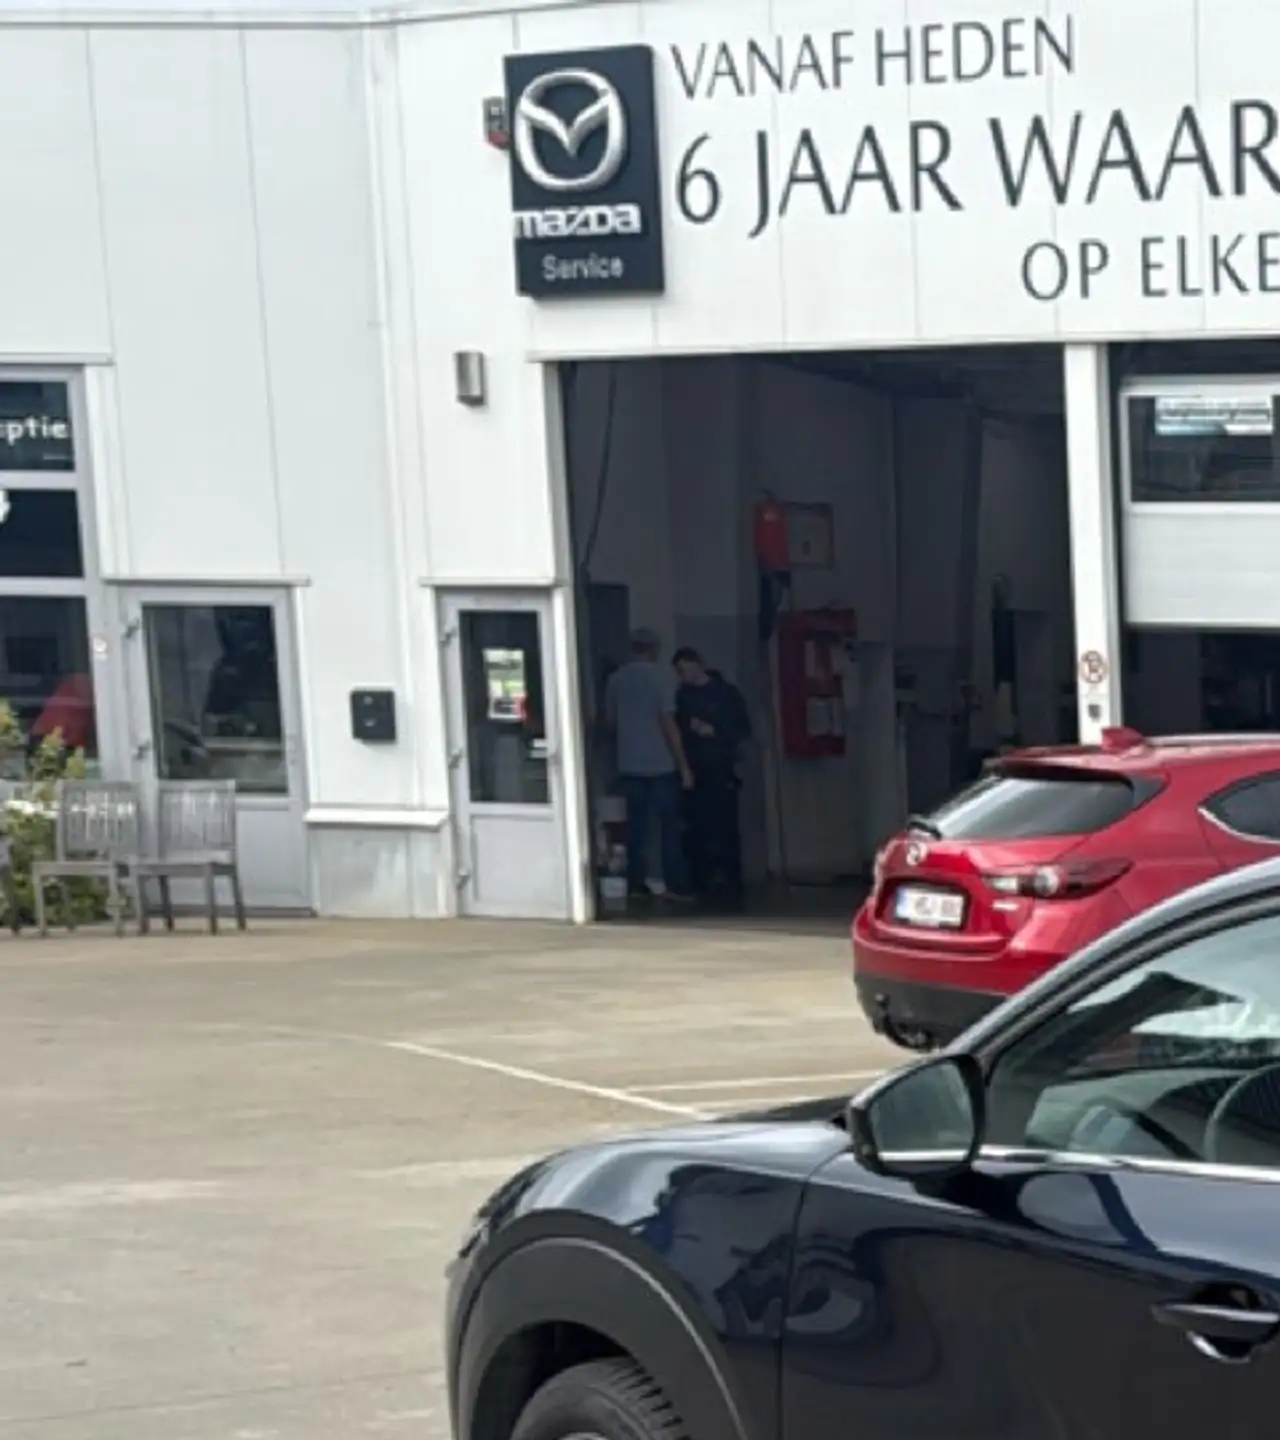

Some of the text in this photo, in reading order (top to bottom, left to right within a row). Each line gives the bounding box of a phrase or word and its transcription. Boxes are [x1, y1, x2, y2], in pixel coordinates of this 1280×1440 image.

[670, 13, 1075, 100] VANAF HEDEN
[675, 132, 723, 225] 6
[748, 119, 965, 239] JAAR
[540, 252, 625, 281] Service
[1021, 238, 1110, 301] OP
